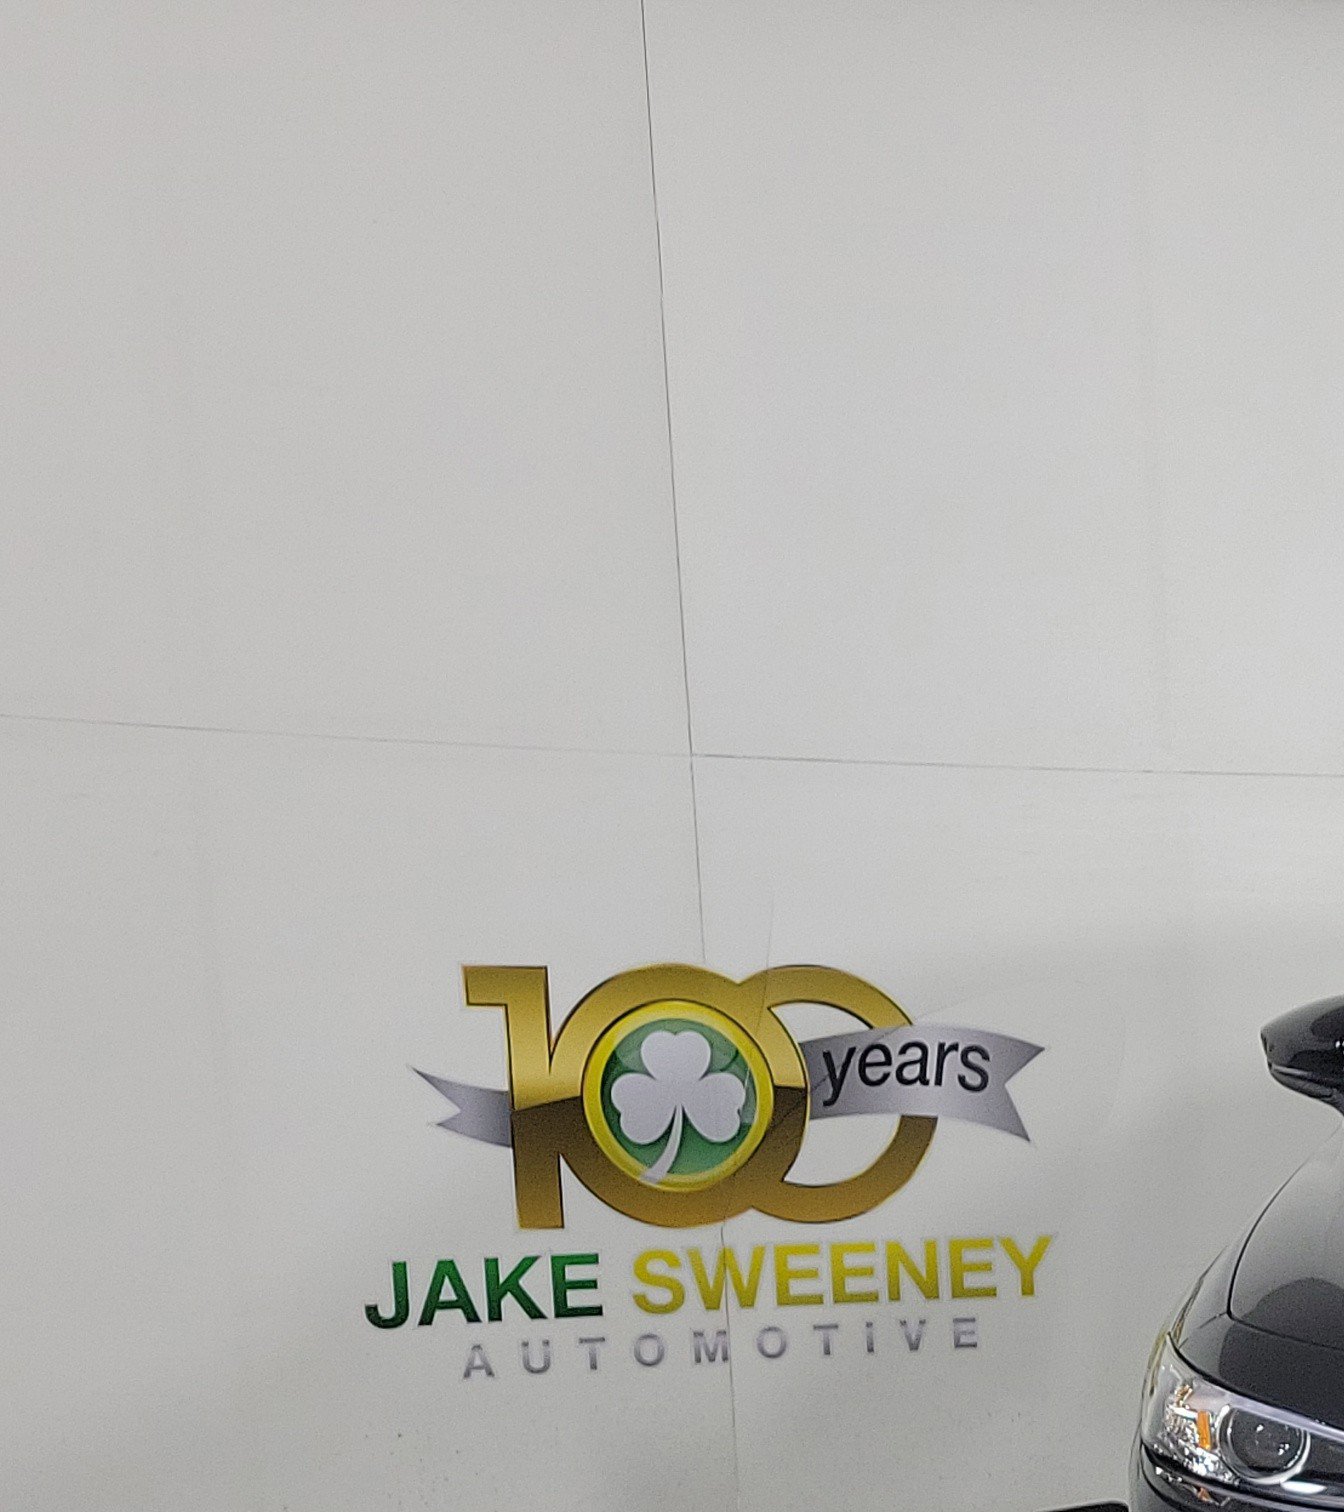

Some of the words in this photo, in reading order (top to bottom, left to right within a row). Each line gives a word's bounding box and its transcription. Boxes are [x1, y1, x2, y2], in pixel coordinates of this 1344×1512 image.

[821, 1040, 991, 1106] years
[364, 1252, 604, 1331] JAKE
[631, 1235, 1053, 1314] SWEENEY
[462, 1317, 979, 1380] AUTOMOTIVE
